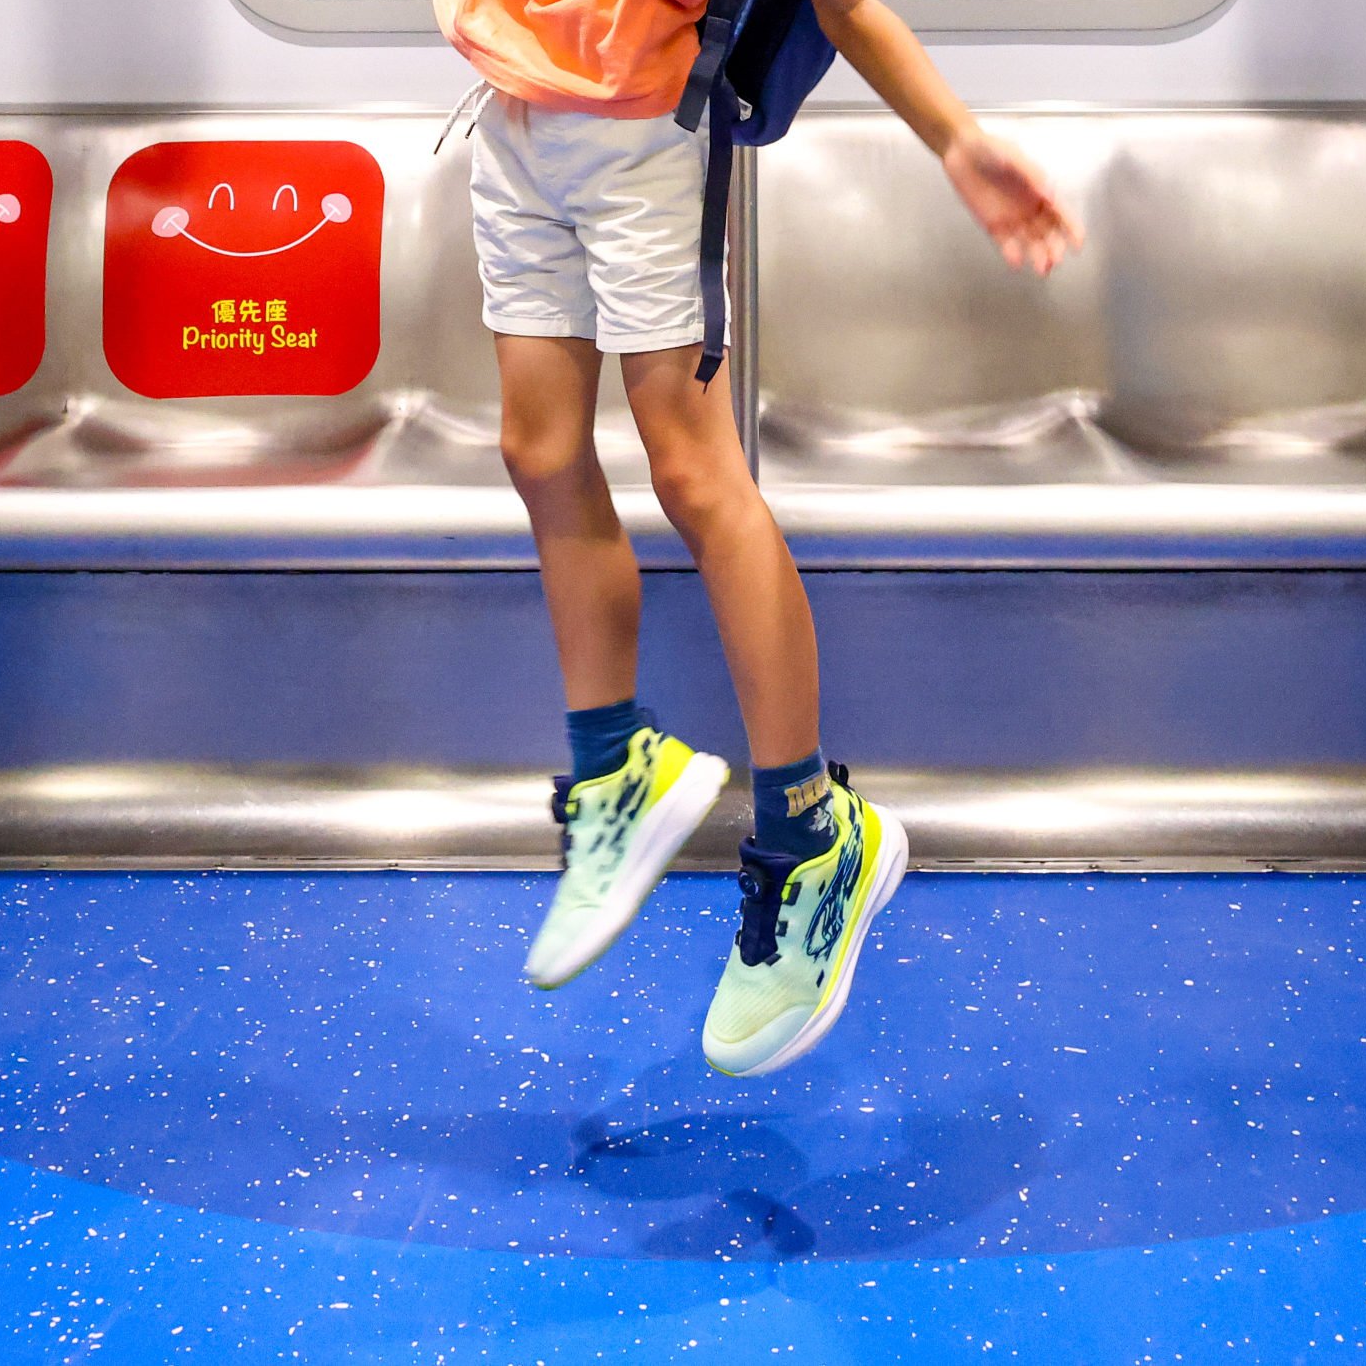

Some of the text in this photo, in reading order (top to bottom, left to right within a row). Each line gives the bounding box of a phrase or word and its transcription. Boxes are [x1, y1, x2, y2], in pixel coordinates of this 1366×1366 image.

[212, 299, 287, 324] 優先座
[182, 325, 318, 355] Priority Seat
